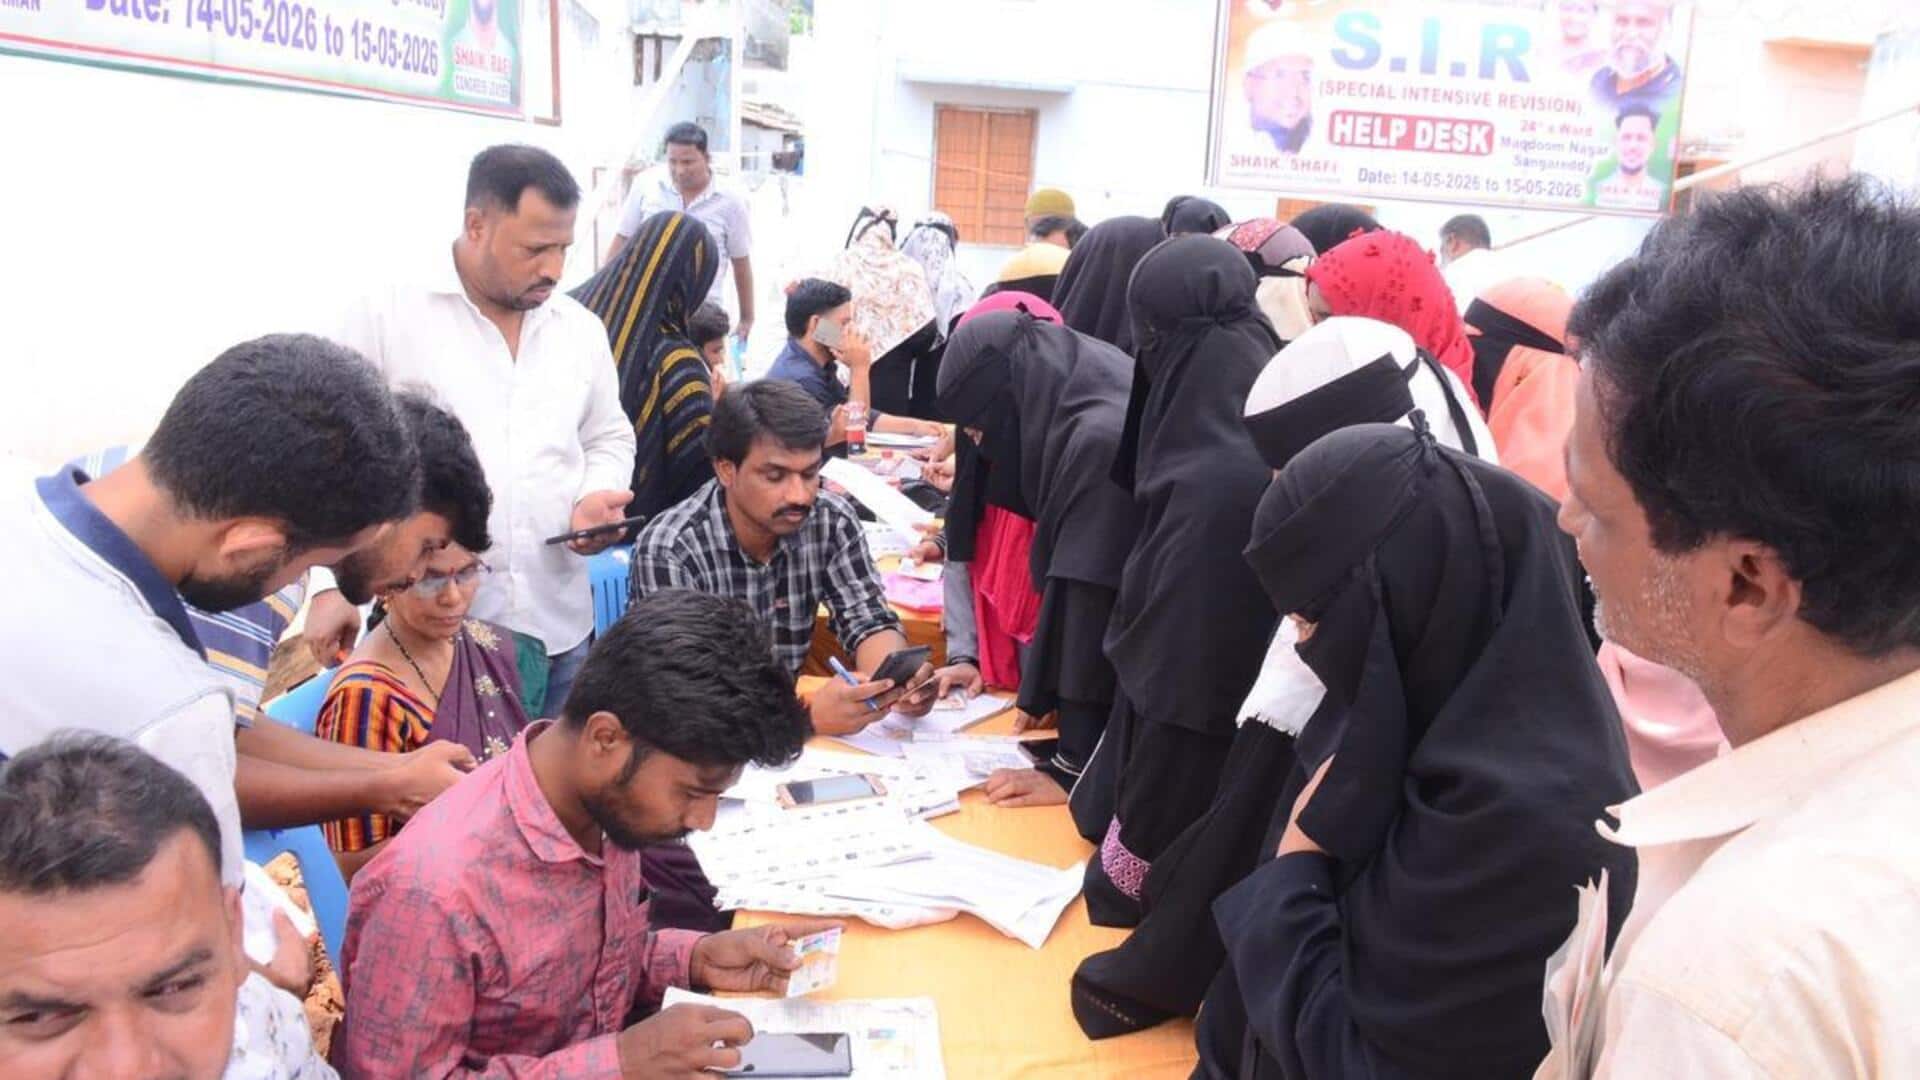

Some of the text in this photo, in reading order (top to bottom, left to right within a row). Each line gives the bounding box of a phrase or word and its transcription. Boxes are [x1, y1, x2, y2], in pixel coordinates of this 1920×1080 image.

[186, 0, 317, 51] 14-05-2026
[325, 14, 344, 56] to
[351, 18, 438, 77] 15-05-2026
[1331, 11, 1531, 83] S.I.R
[1319, 80, 1582, 115] (SPECIAL INTENSIVE REVISION)
[1333, 112, 1491, 155] HELP DESK
[1290, 157, 1338, 174] SHAFI
[1358, 167, 1397, 185] Date:
[1486, 177, 1499, 191] to
